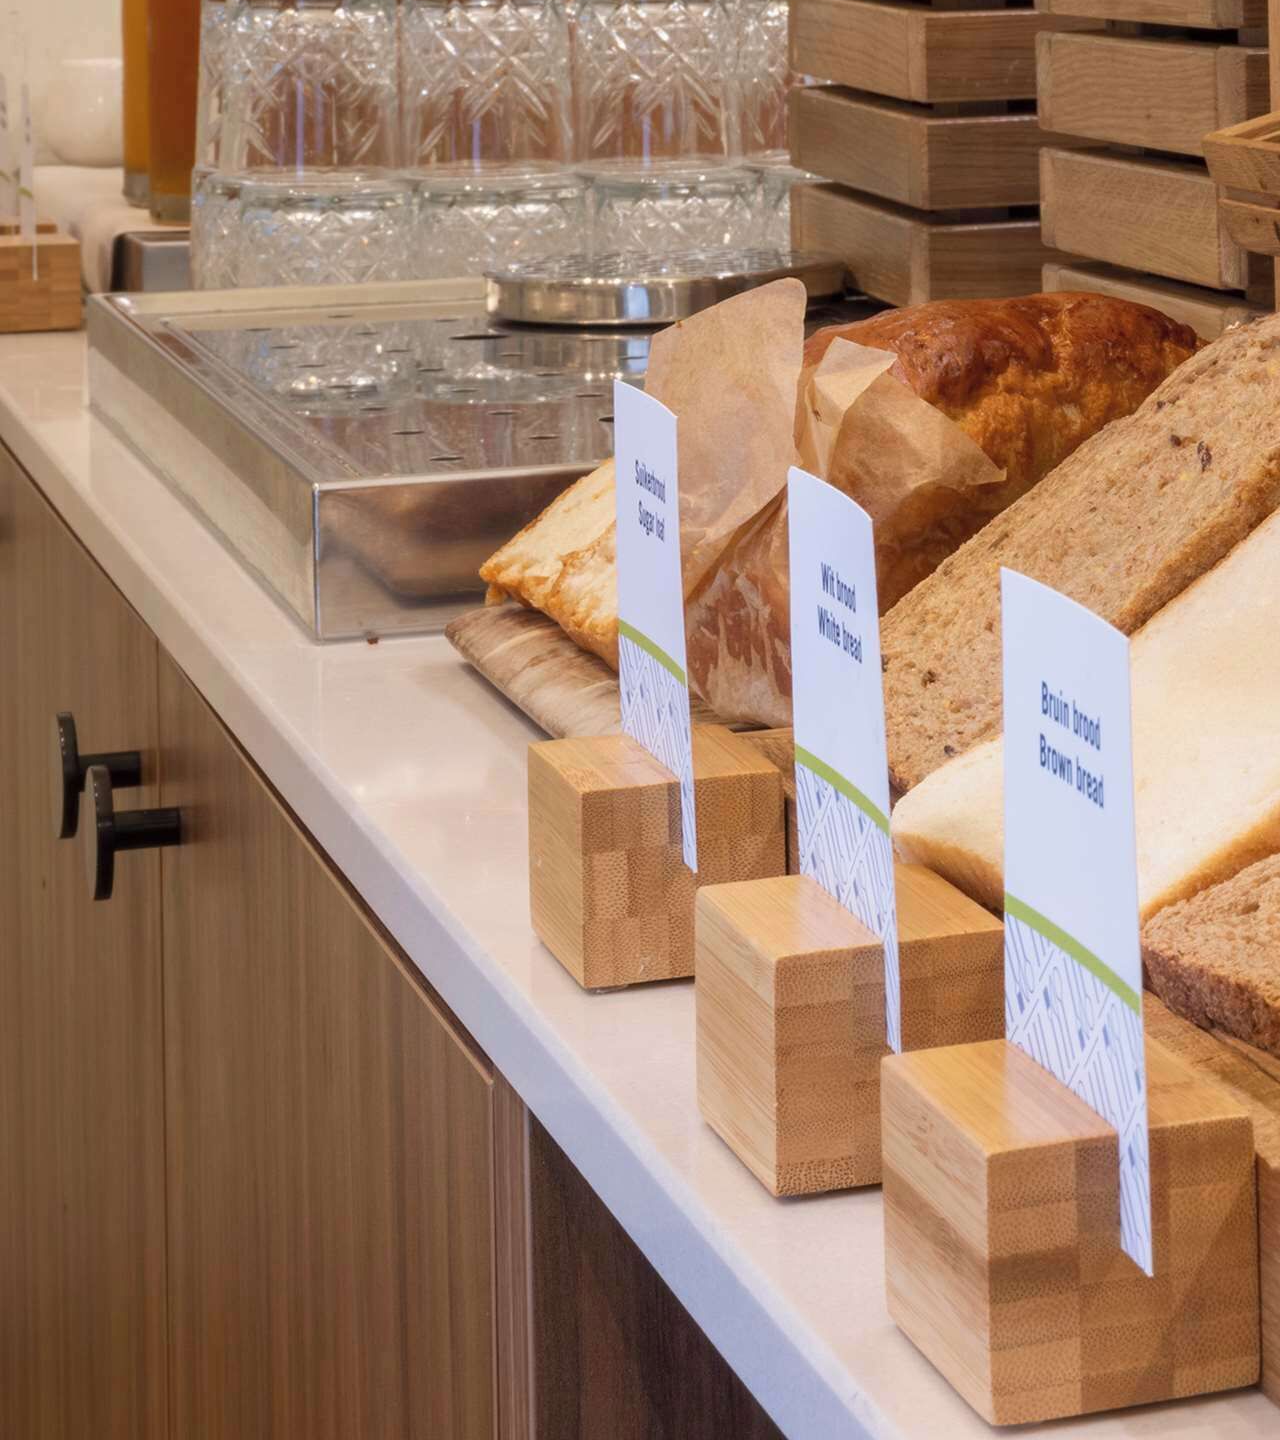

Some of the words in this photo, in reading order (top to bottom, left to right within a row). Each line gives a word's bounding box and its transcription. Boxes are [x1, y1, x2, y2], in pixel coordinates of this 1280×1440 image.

[639, 500, 654, 536] Sugar
[820, 561, 835, 599] Wit
[836, 571, 856, 613] brood
[817, 604, 840, 647] White
[842, 621, 862, 664] bread
[1041, 680, 1069, 729] Bruin
[1073, 699, 1101, 752] brood
[1040, 732, 1072, 786] Brown
[1076, 755, 1104, 808] bread
